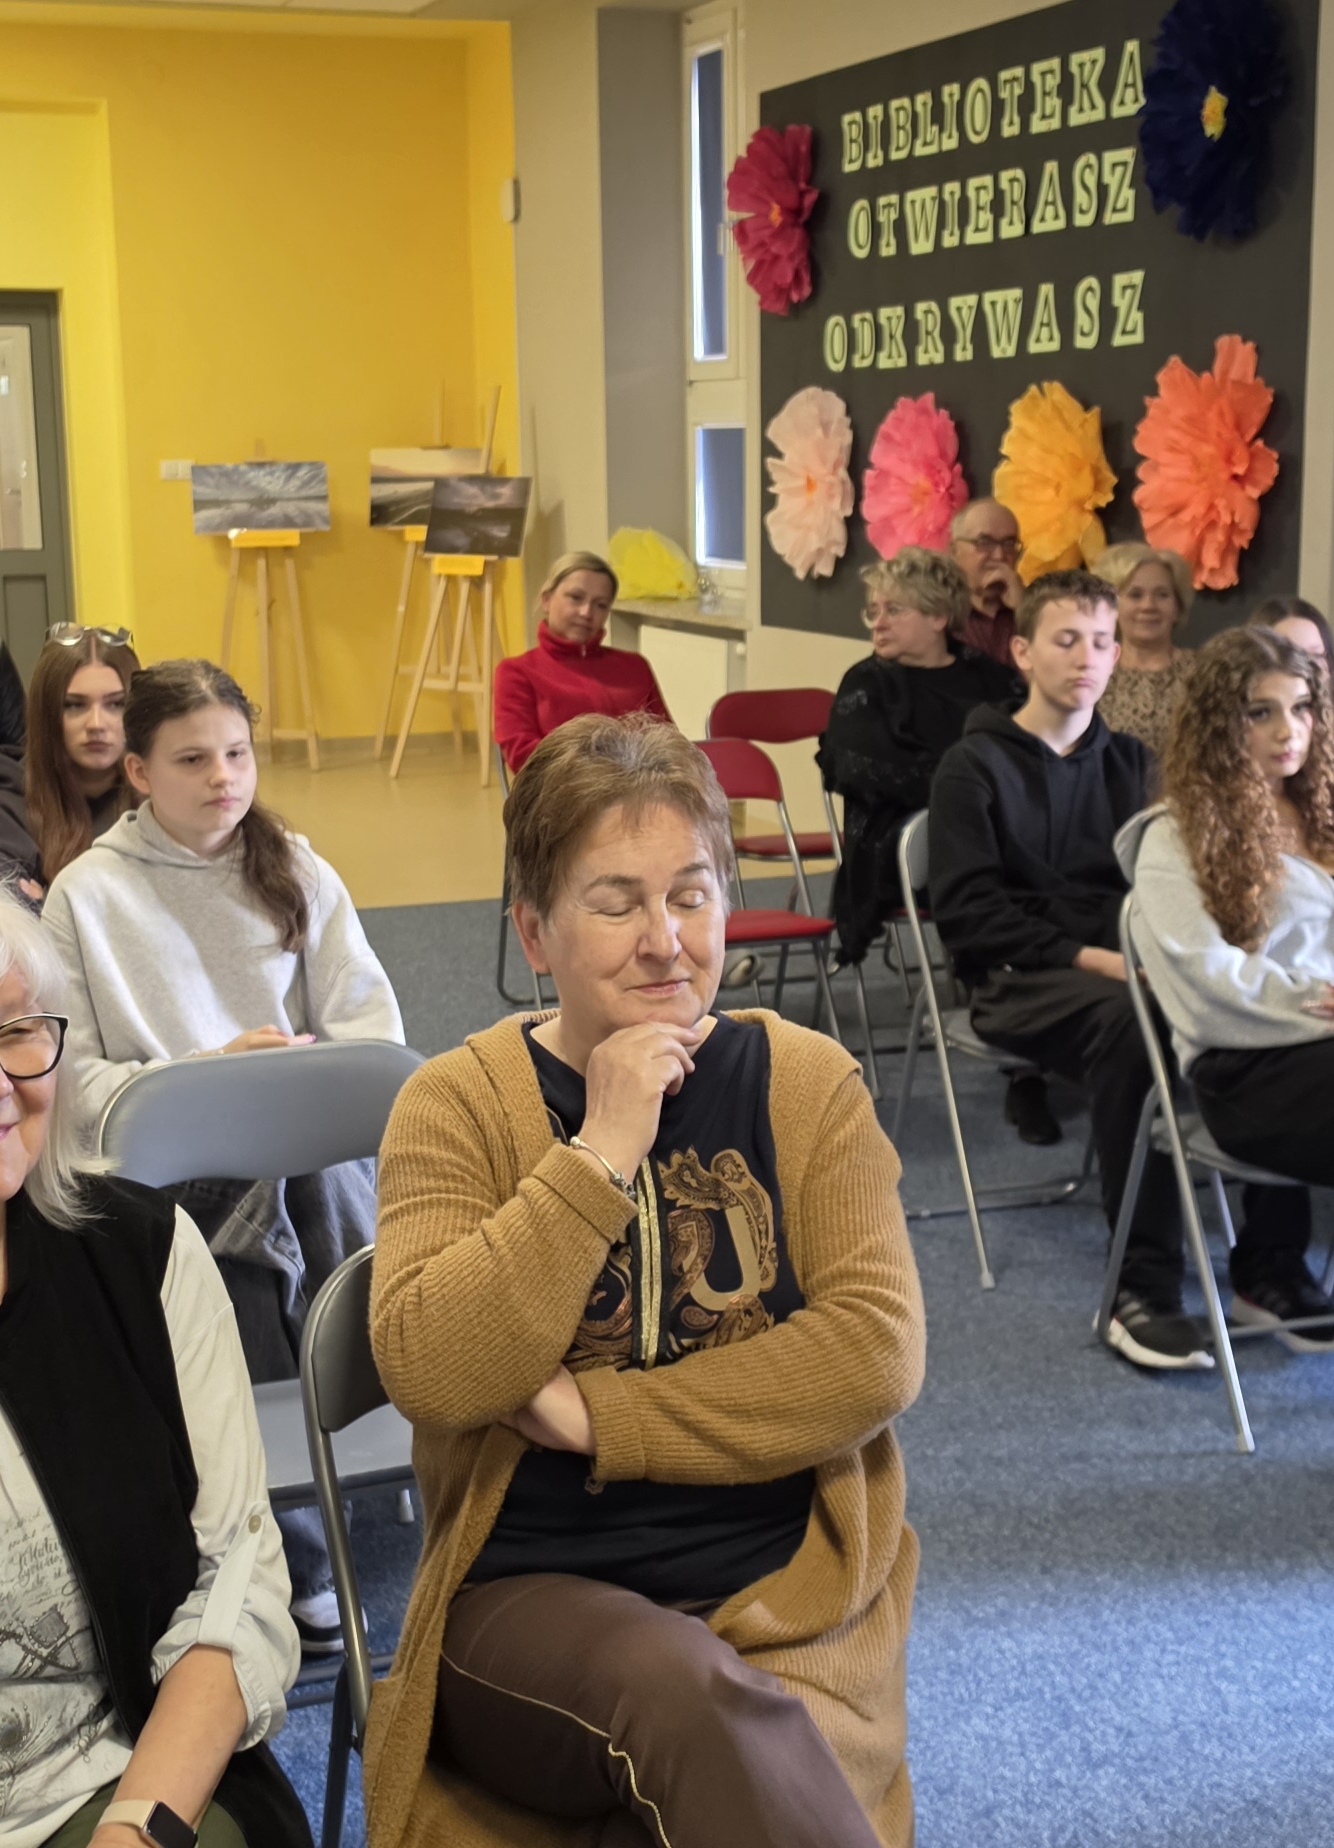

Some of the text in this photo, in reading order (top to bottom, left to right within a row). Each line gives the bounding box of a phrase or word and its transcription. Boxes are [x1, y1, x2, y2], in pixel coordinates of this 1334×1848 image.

[841, 40, 1147, 173] BIBLIOTEKA
[847, 147, 1136, 259] OTWIERASZ
[824, 270, 1146, 373] ODKRYWASZ
